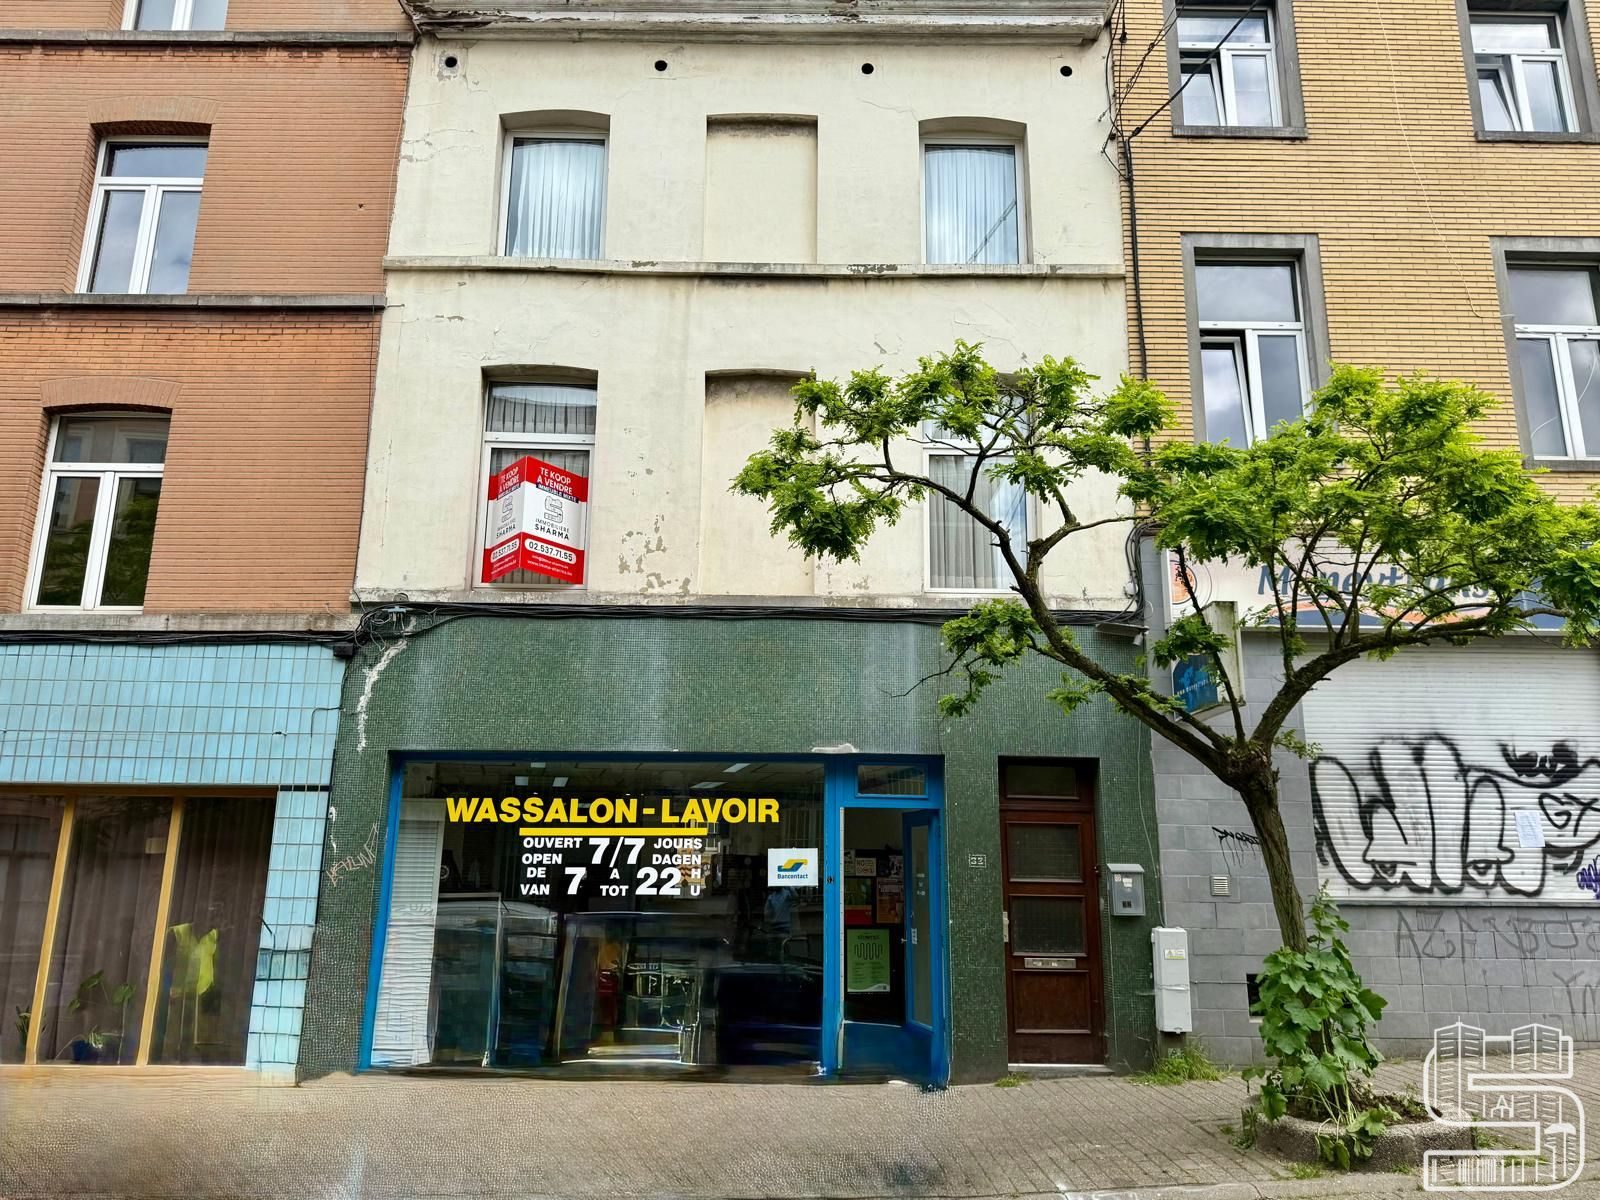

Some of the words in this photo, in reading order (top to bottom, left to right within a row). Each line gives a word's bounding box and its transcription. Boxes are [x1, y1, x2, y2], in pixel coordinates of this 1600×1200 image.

[537, 475, 543, 484] A
[544, 477, 573, 496] VENDRE
[539, 467, 549, 477] TE
[550, 471, 571, 485] KOOP
[534, 523, 570, 541] SHARMA
[528, 541, 573, 562] 02.537.71.55
[446, 796, 638, 824] WASSALON
[661, 798, 780, 824] LAVOIR
[521, 853, 563, 865] OPEN
[652, 853, 702, 866] DAGEN
[523, 837, 583, 849] OUVERT
[588, 837, 646, 868] 7/7
[653, 837, 703, 850] JOURS
[970, 857, 984, 865] 32
[520, 883, 550, 896] VAN
[599, 884, 629, 897] TOT
[690, 884, 701, 897] U
[526, 866, 547, 878] DE
[564, 867, 587, 895] 7
[609, 868, 620, 880] A
[635, 866, 682, 896] 22
[690, 867, 702, 879] H
